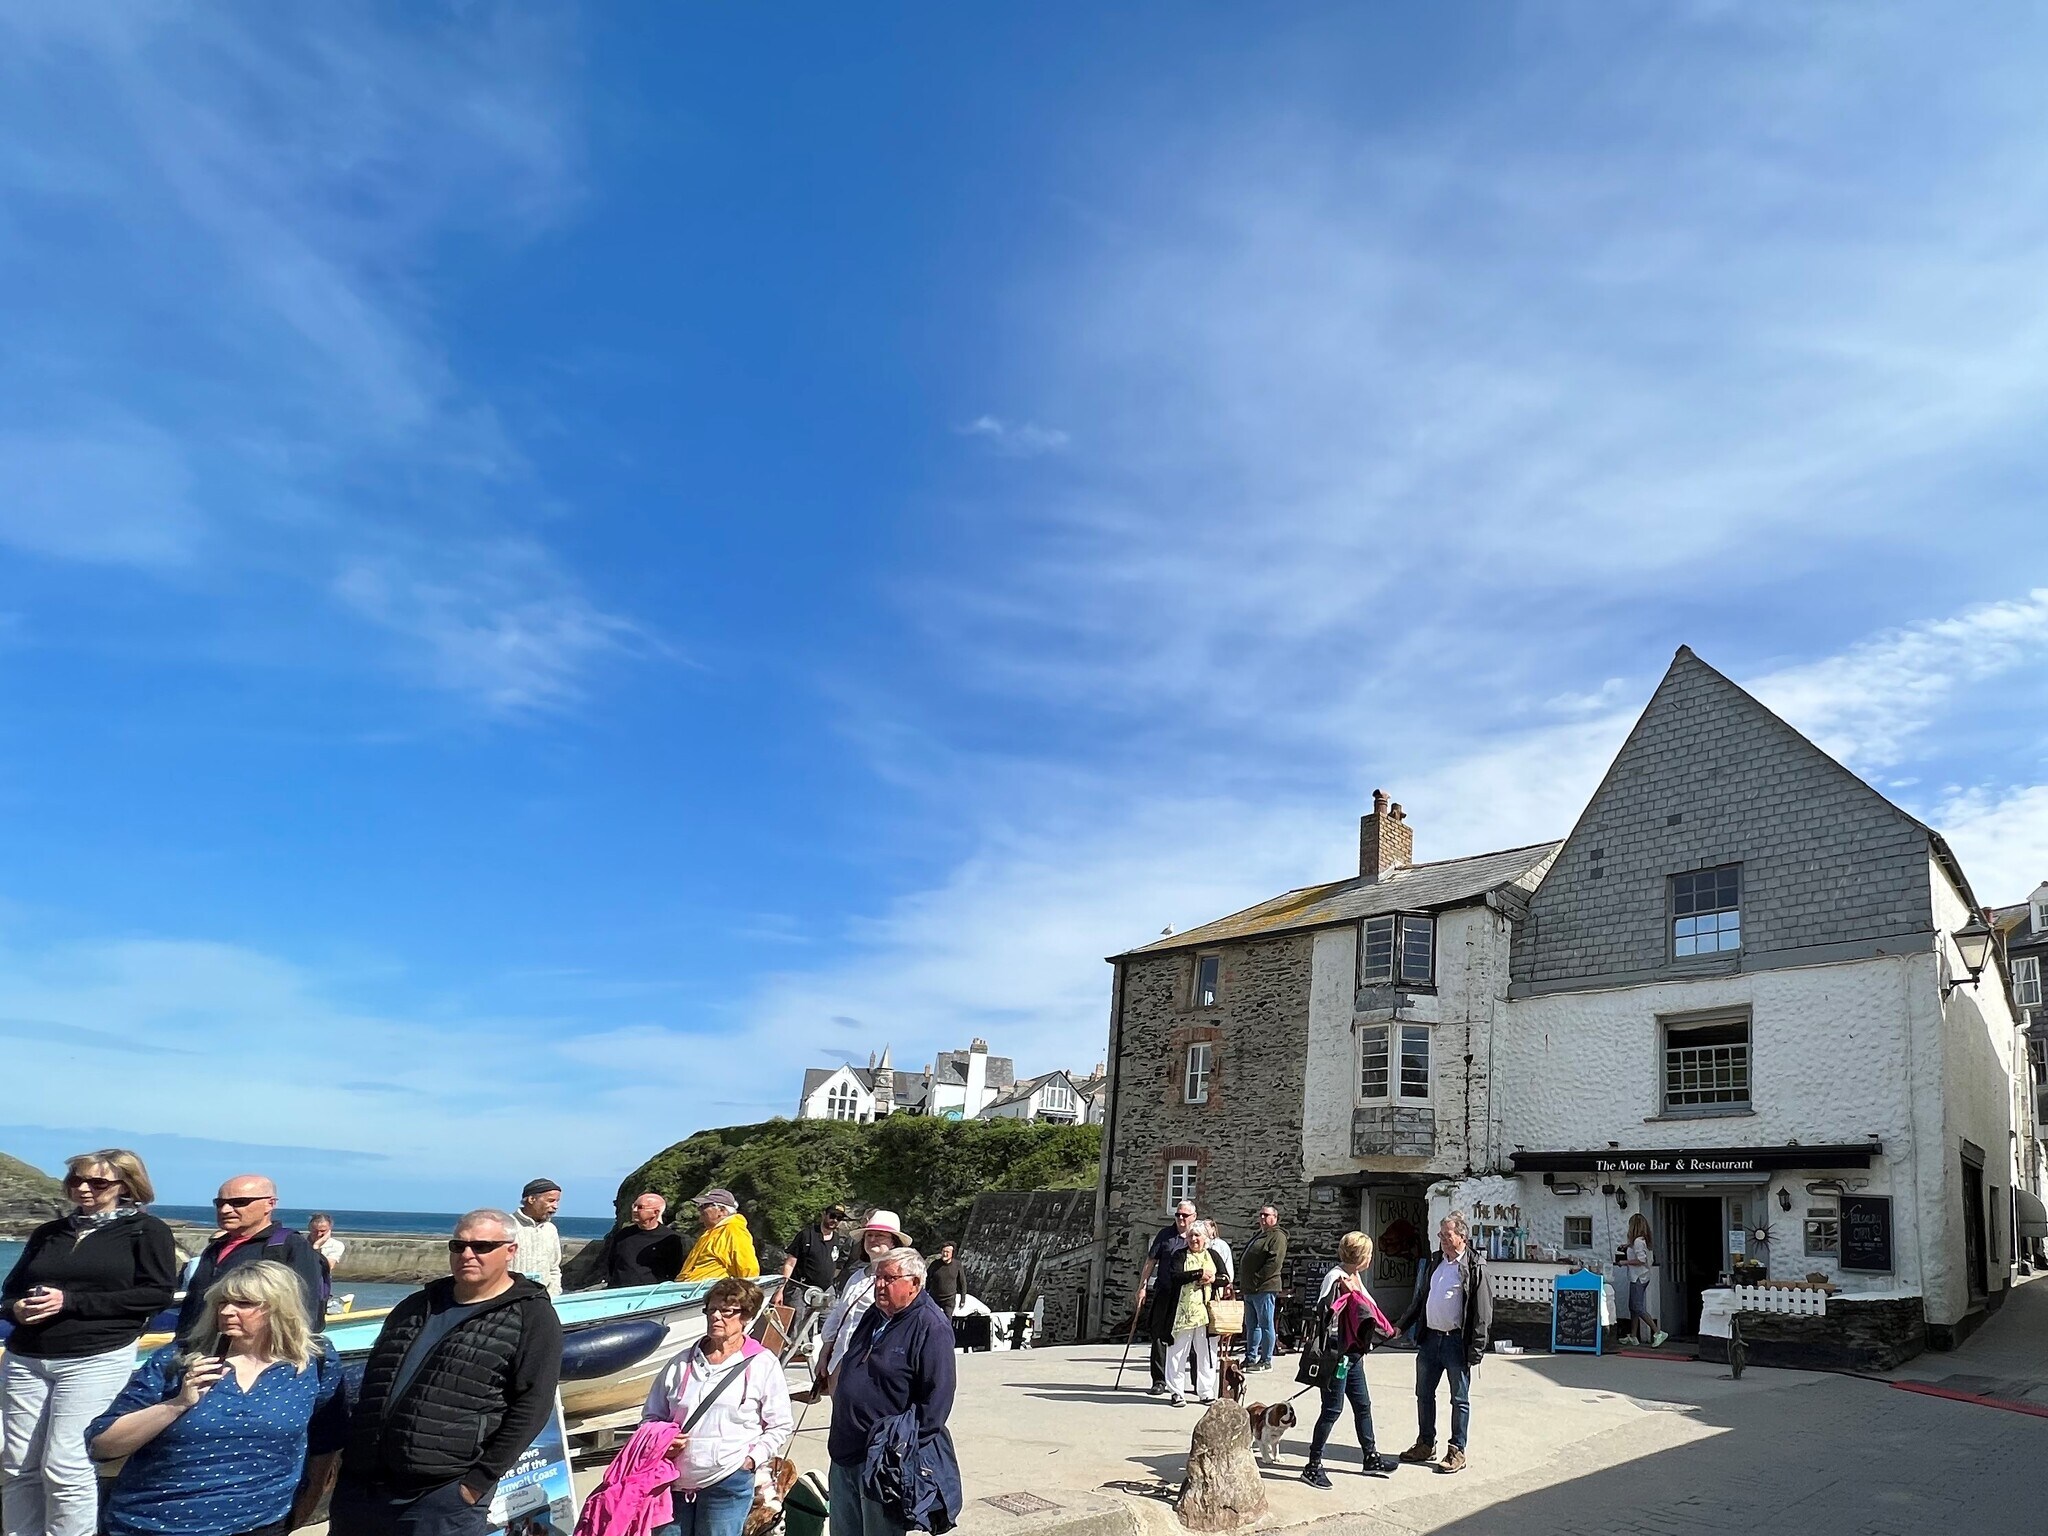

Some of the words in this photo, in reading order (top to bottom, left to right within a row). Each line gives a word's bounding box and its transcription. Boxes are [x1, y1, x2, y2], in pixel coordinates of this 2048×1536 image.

[1596, 1160, 1616, 1171] The
[1618, 1160, 1646, 1171] Mote
[1650, 1159, 1671, 1170] Bar
[1675, 1159, 1685, 1170] &
[1690, 1158, 1754, 1170] Restaurant
[1380, 1200, 1409, 1224] CRAB
[1412, 1201, 1421, 1226] &
[1472, 1200, 1491, 1220] THE
[516, 1461, 530, 1475] off
[531, 1458, 548, 1470] the
[494, 1475, 532, 1497] ornwall
[532, 1467, 558, 1482] Coast
